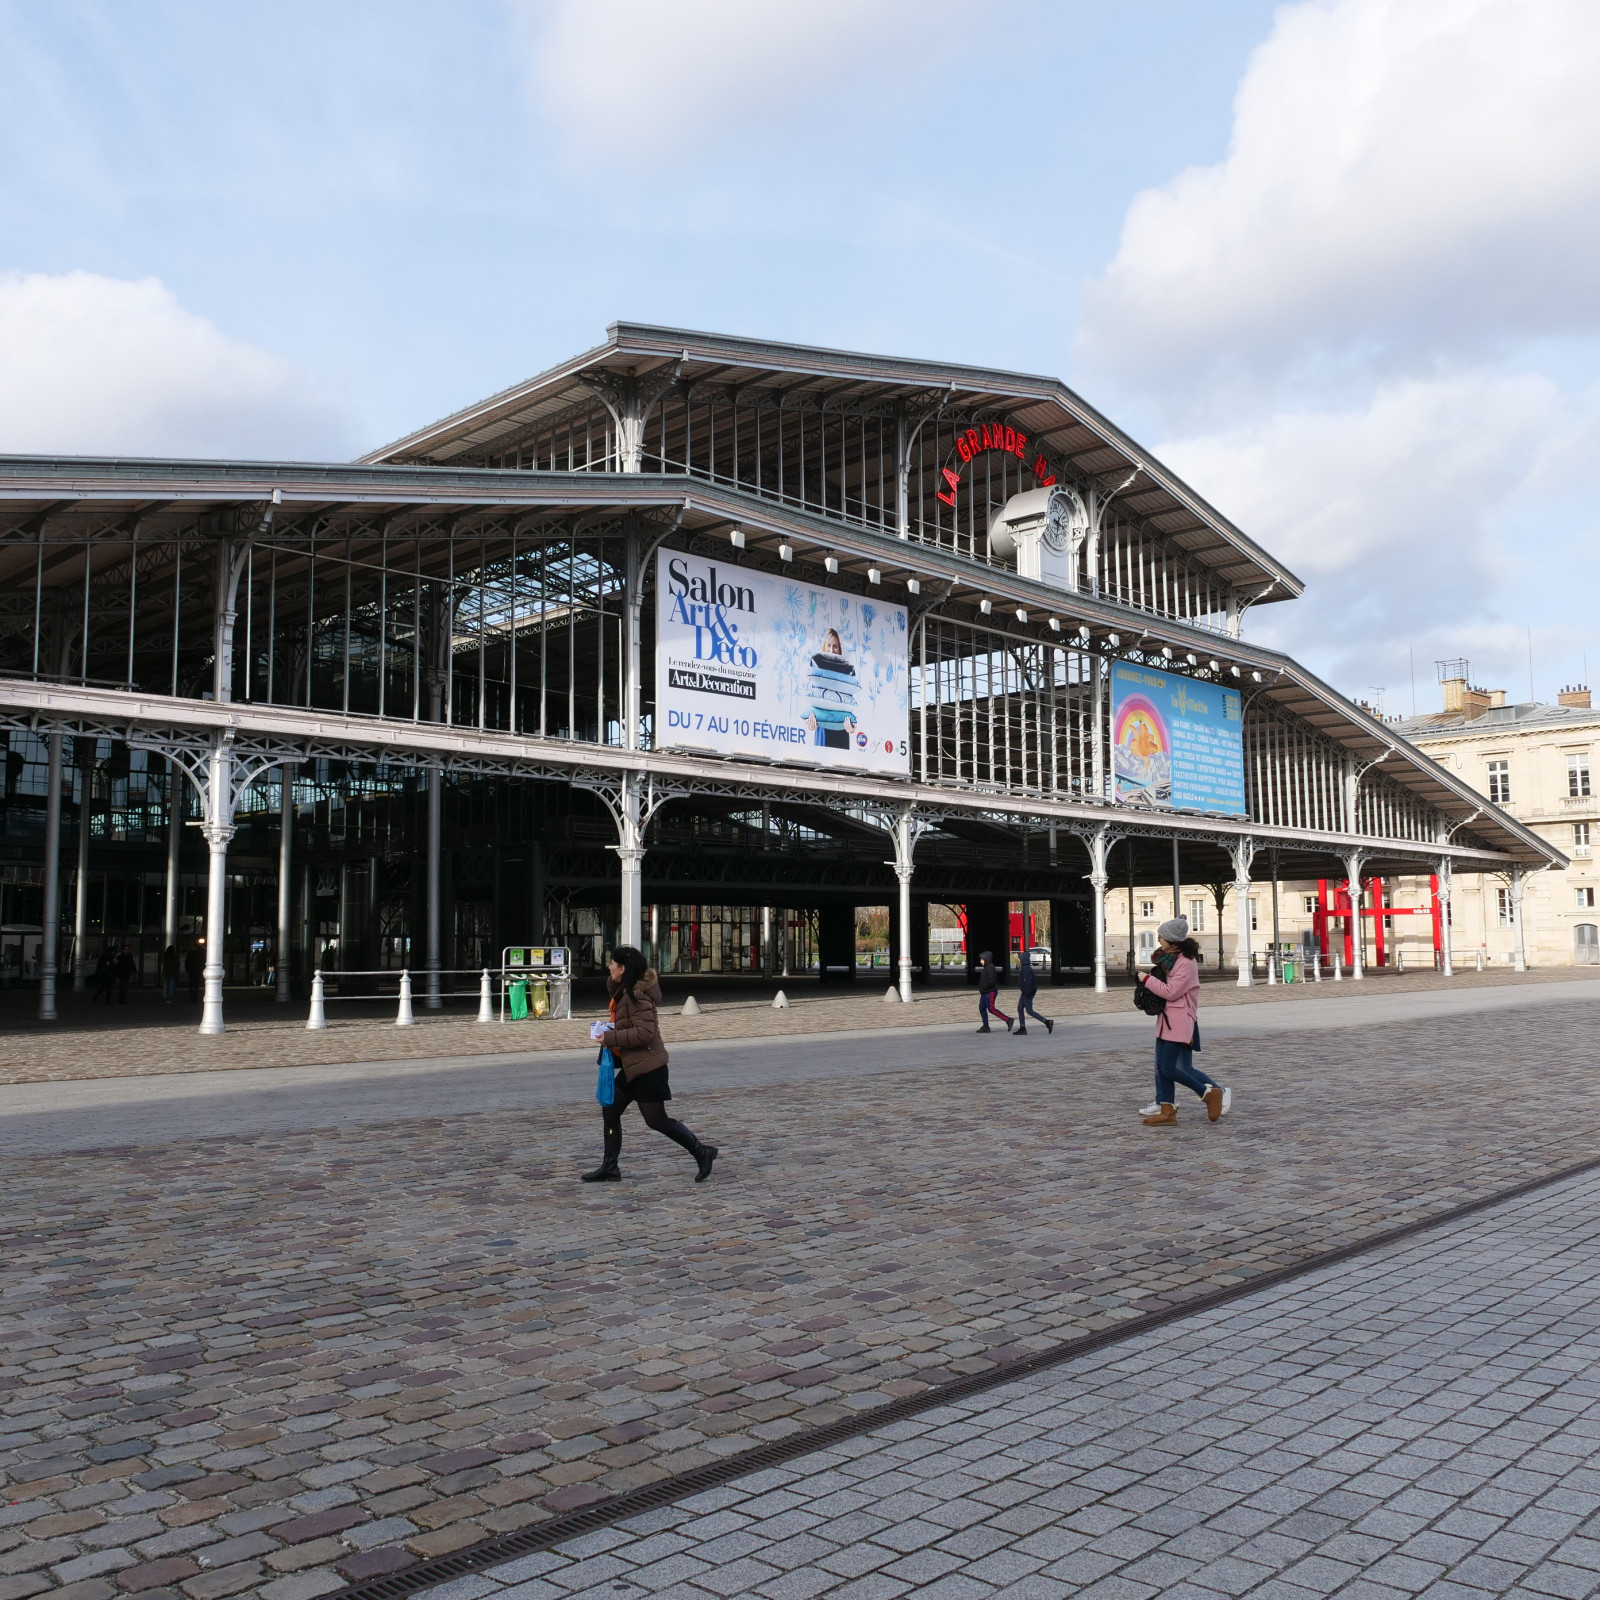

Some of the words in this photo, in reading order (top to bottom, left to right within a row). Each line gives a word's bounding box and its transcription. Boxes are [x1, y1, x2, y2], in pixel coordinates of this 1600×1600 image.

[937, 467, 961, 507] LA
[956, 423, 1027, 462] GRANDE
[669, 558, 757, 613] Salon
[669, 656, 678, 666] Le
[678, 658, 717, 672] rendez-vous
[718, 665, 727, 674] du
[727, 669, 757, 680] magazine
[668, 710, 691, 729] DU
[695, 714, 704, 730] 7
[707, 715, 729, 734] AU
[733, 719, 750, 737] 10
[753, 719, 806, 745] FÉVRIER
[900, 740, 907, 756] 5
